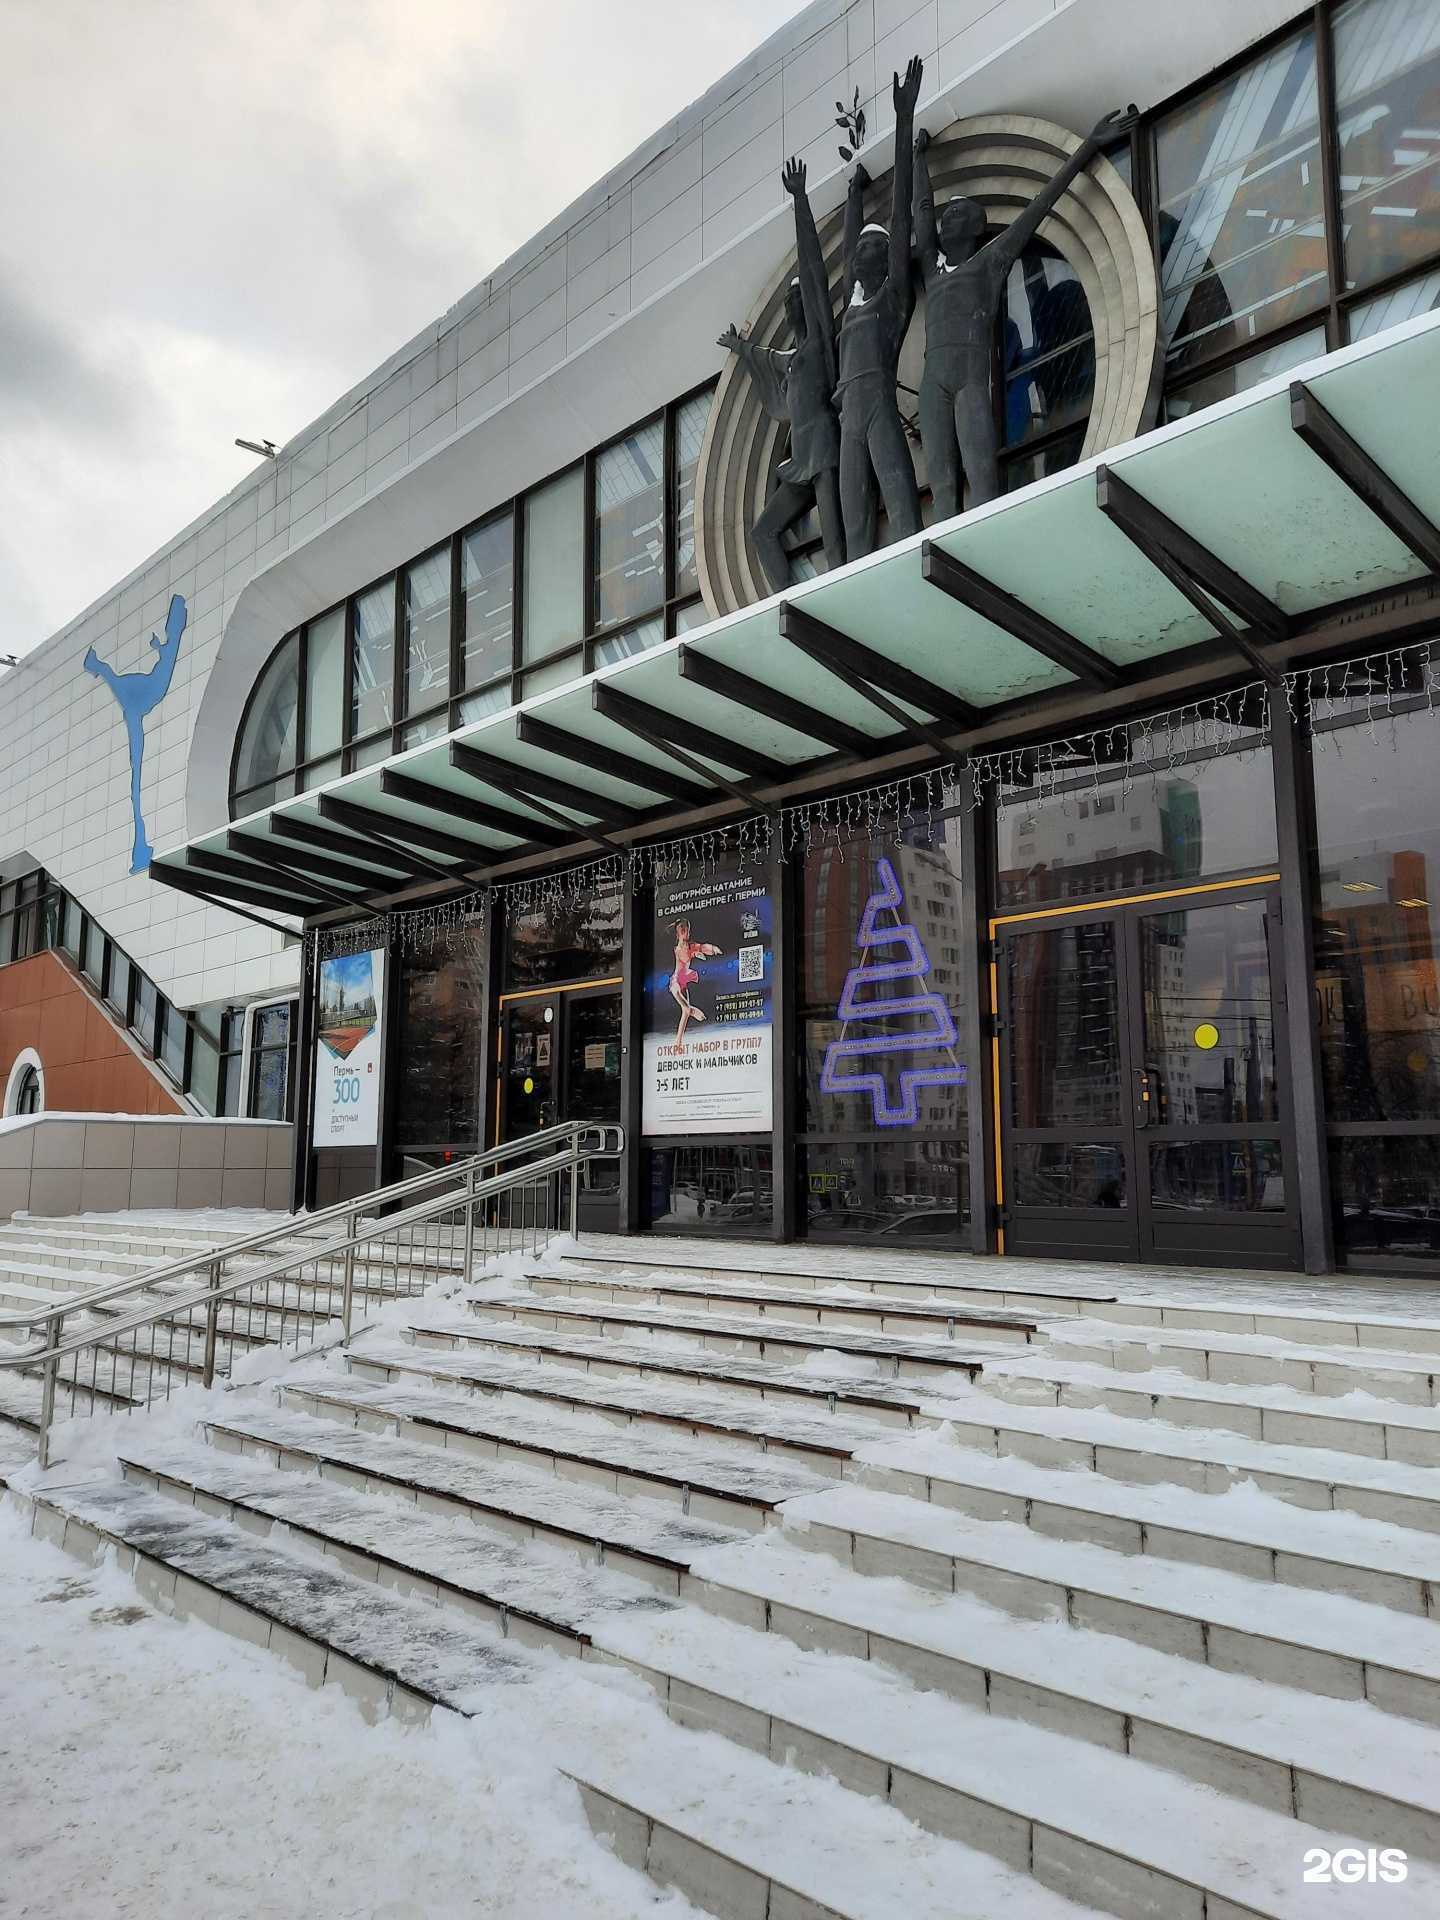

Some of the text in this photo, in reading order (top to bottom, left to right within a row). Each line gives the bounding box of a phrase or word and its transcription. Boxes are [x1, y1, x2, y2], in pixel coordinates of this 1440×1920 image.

[669, 877, 753, 901] ФИГУРНОЕ КАТАНИЕ
[664, 902, 694, 915] САМОМ
[695, 896, 727, 909] ЦЕНТРЕ
[727, 894, 734, 903] Г.
[735, 887, 766, 901] ПЕРМИ
[657, 1037, 762, 1056] ОТКРЫТ НАБОР В ГРУППУ
[333, 1065, 354, 1078] Пермь
[657, 1053, 758, 1072] ДЕВОЧЕК И МАЛЬЧИКОВ
[333, 1078, 360, 1104] 300
[656, 1077, 690, 1092] 3-5 ЛЕТ
